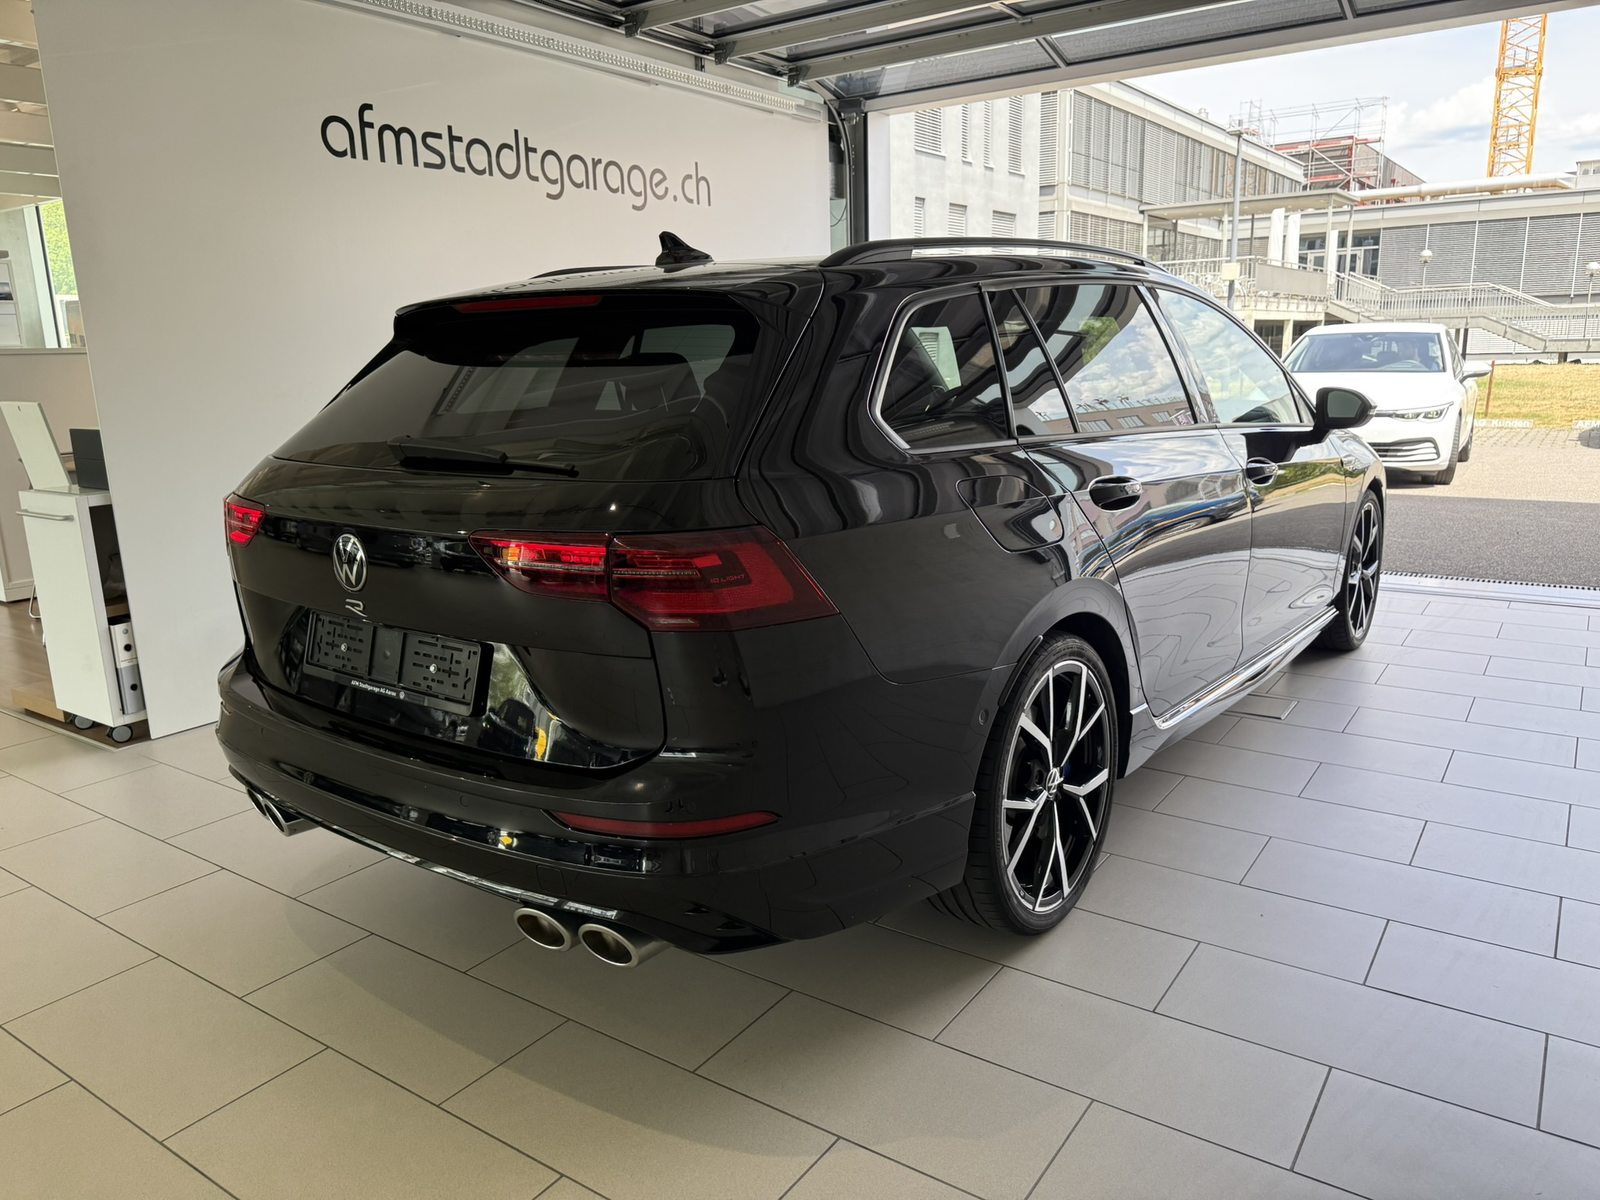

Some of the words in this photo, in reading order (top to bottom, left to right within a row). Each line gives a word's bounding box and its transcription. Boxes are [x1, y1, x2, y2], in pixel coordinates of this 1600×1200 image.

[320, 103, 711, 211] afmstadtgarage.ch
[1491, 419, 1530, 428] Kunden
[333, 533, 367, 592] VW
